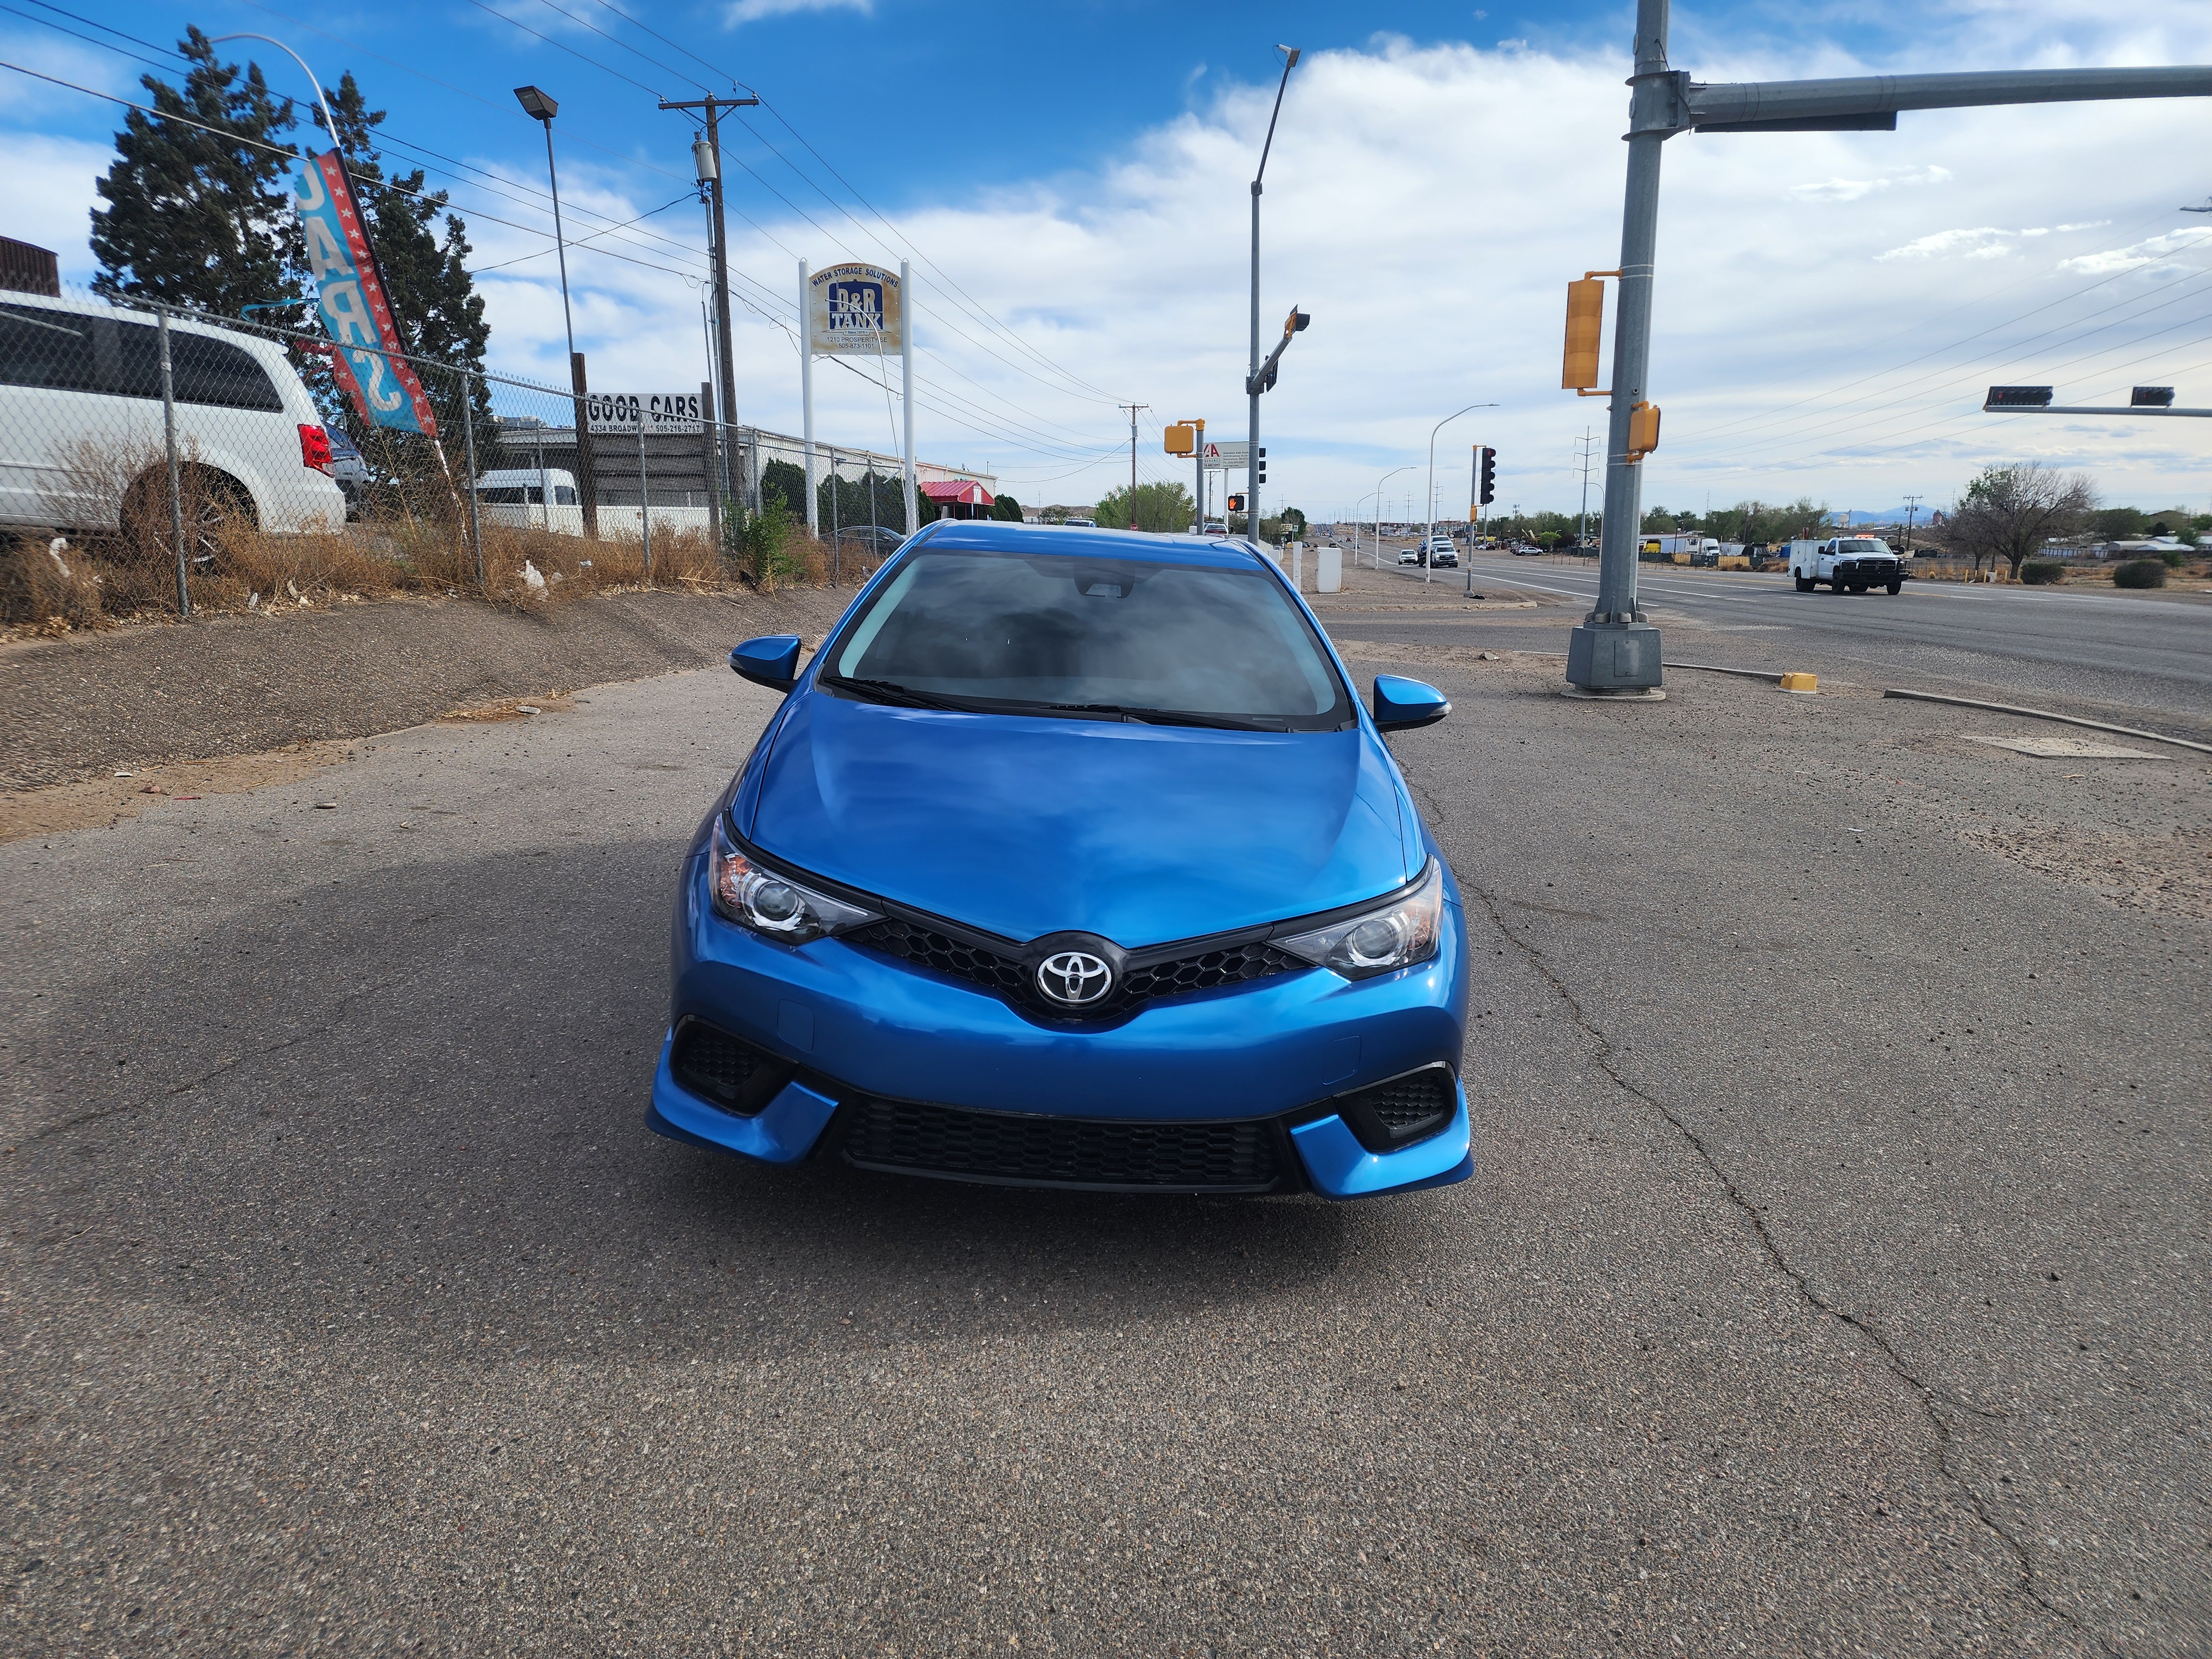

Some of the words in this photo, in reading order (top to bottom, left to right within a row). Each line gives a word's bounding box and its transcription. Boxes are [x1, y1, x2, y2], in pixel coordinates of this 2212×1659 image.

[812, 272, 832, 287] WATER
[834, 268, 862, 277] STORAGE
[865, 269, 899, 288] SOLUTIONS
[838, 288, 875, 312] D&R
[832, 313, 881, 330] TANK
[588, 394, 640, 422] GOOD
[650, 395, 698, 422] CARS
